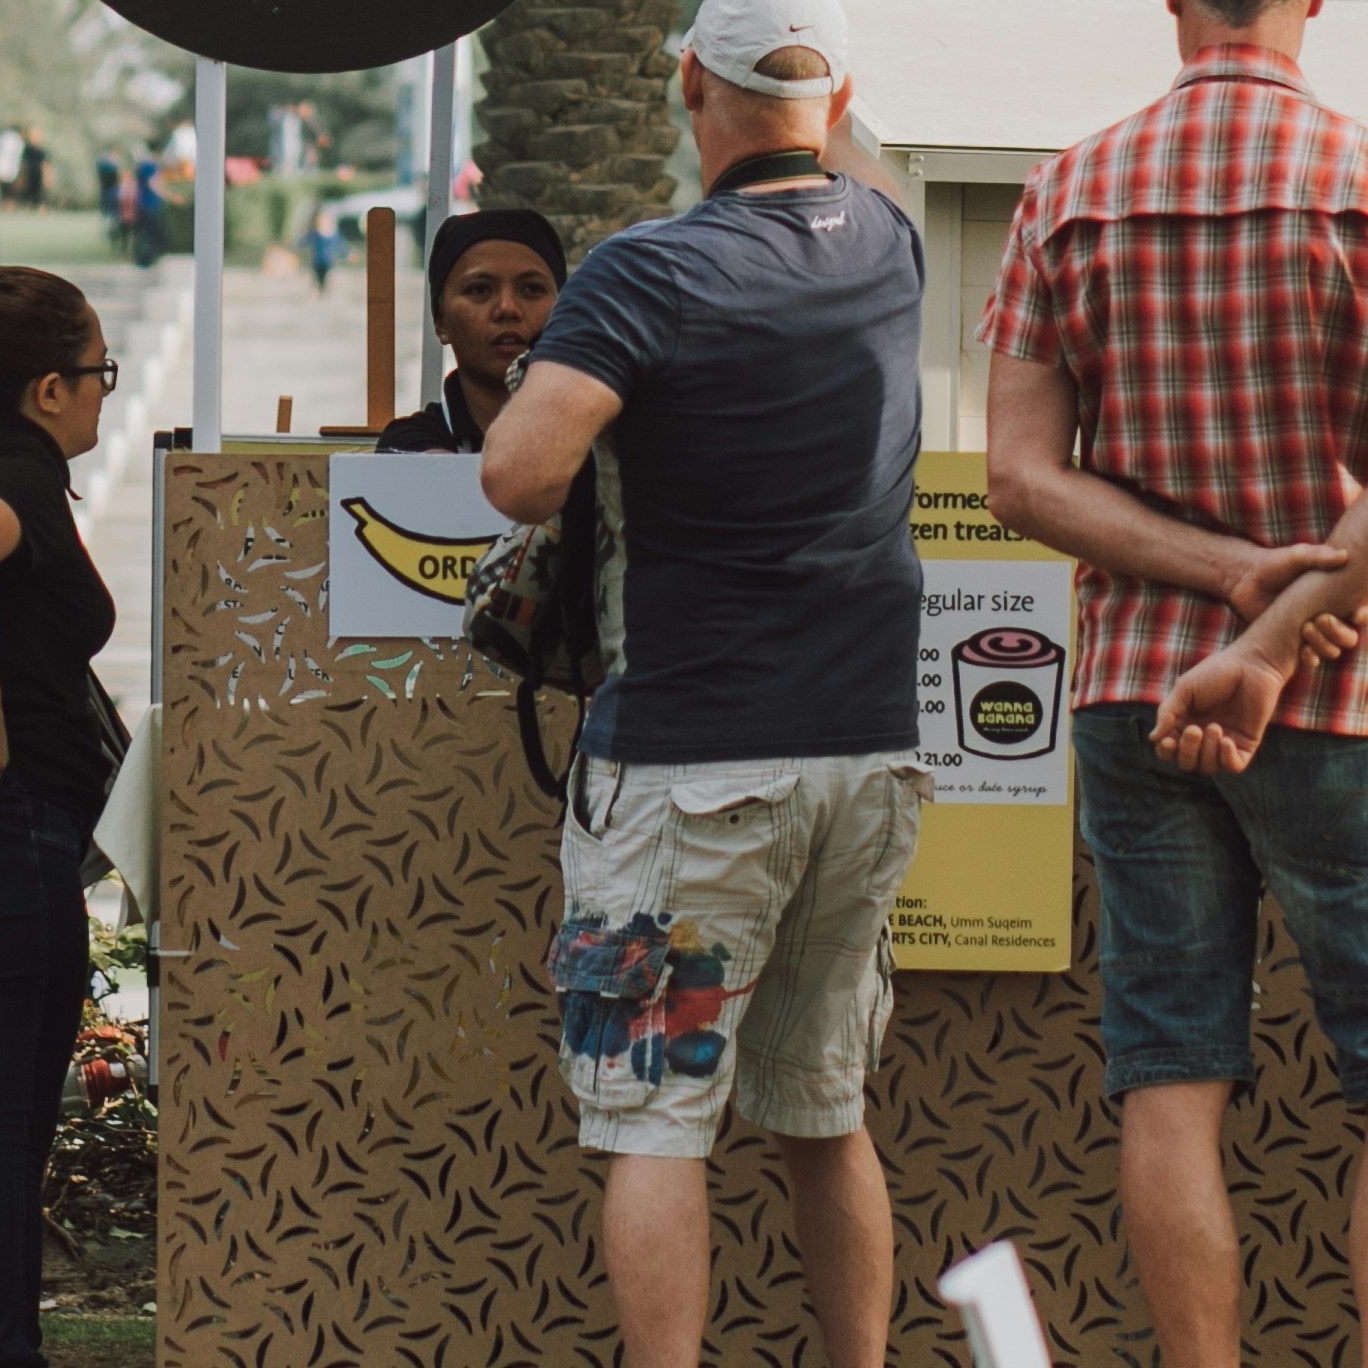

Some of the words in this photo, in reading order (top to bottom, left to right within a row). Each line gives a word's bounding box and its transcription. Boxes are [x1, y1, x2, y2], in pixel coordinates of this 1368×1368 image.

[909, 522, 948, 541] zen
[921, 588, 985, 617] egular
[991, 591, 1034, 612] size
[924, 752, 962, 766] 21.00
[978, 781, 1003, 792] date
[1007, 784, 1047, 797] syrup
[895, 895, 927, 909] tion:
[898, 914, 947, 929] BEACH,
[950, 916, 983, 928] Umm
[987, 916, 1033, 931] Suqeim
[891, 932, 916, 945] RTS
[919, 932, 951, 948] CITY,
[954, 934, 988, 946] Canal
[991, 935, 1056, 948] Residences
